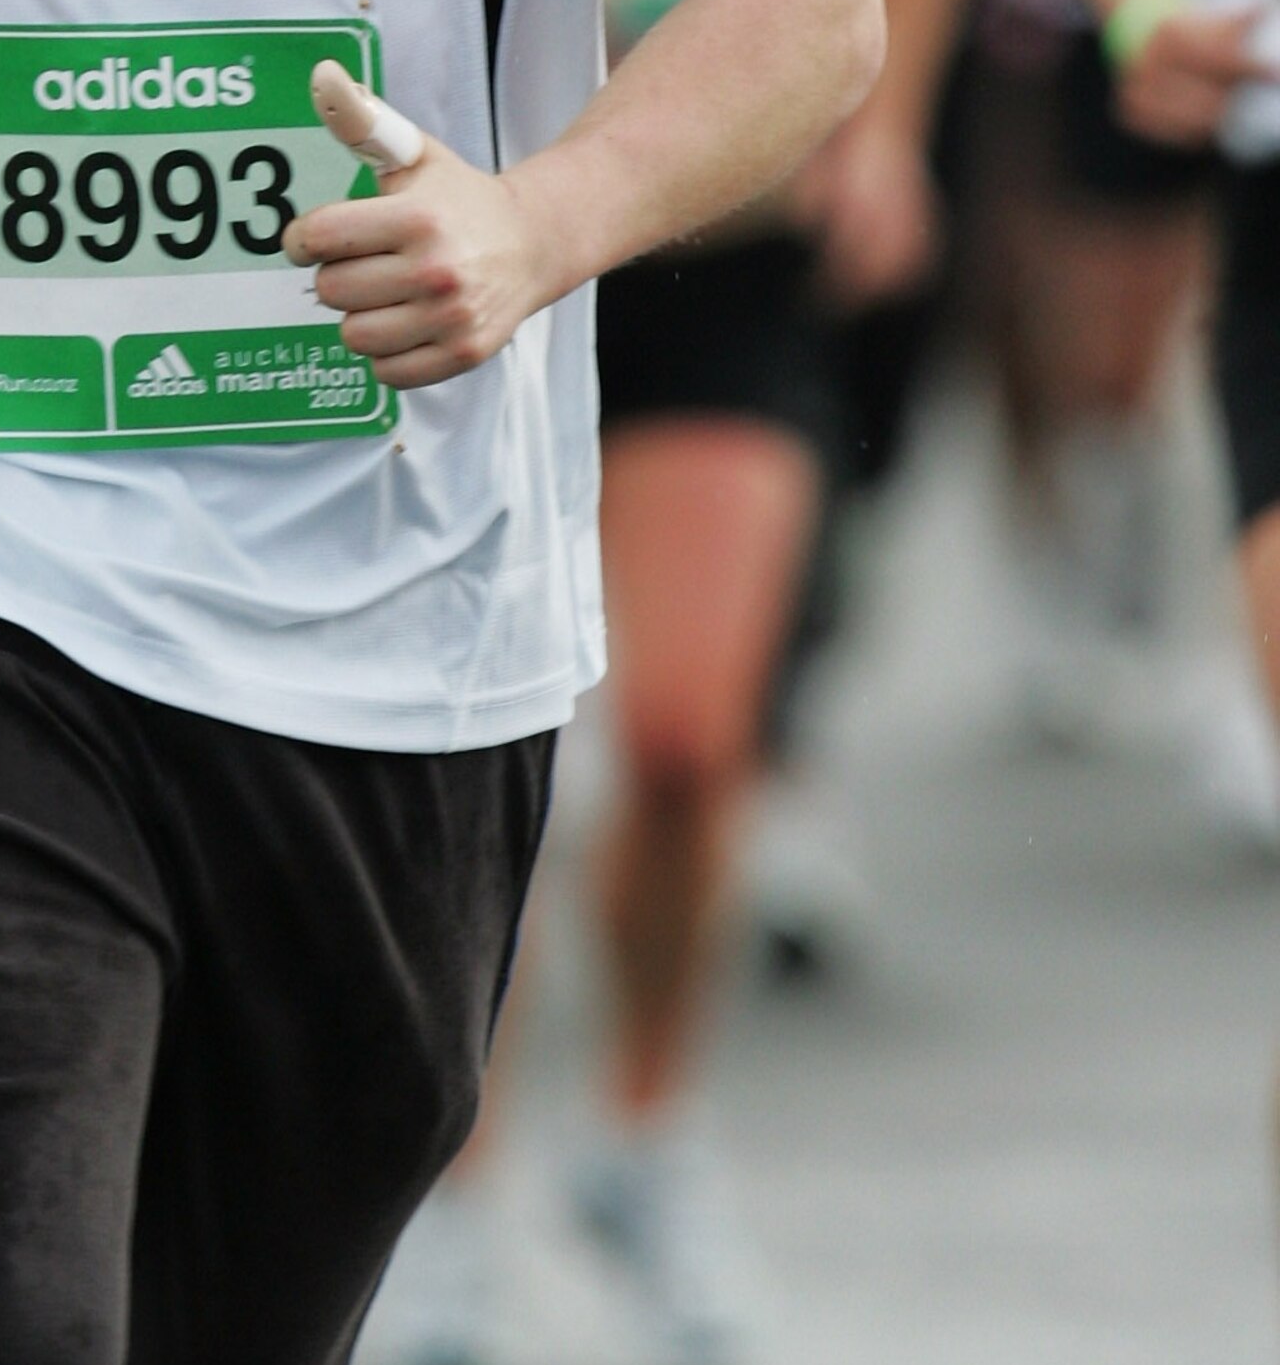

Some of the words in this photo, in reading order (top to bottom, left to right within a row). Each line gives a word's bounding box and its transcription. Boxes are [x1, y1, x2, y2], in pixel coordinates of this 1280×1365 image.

[34, 56, 255, 110] adidas
[0, 144, 297, 263] 8993
[126, 377, 208, 398] adidas
[216, 362, 367, 393] marathon
[308, 387, 368, 410] 2007
